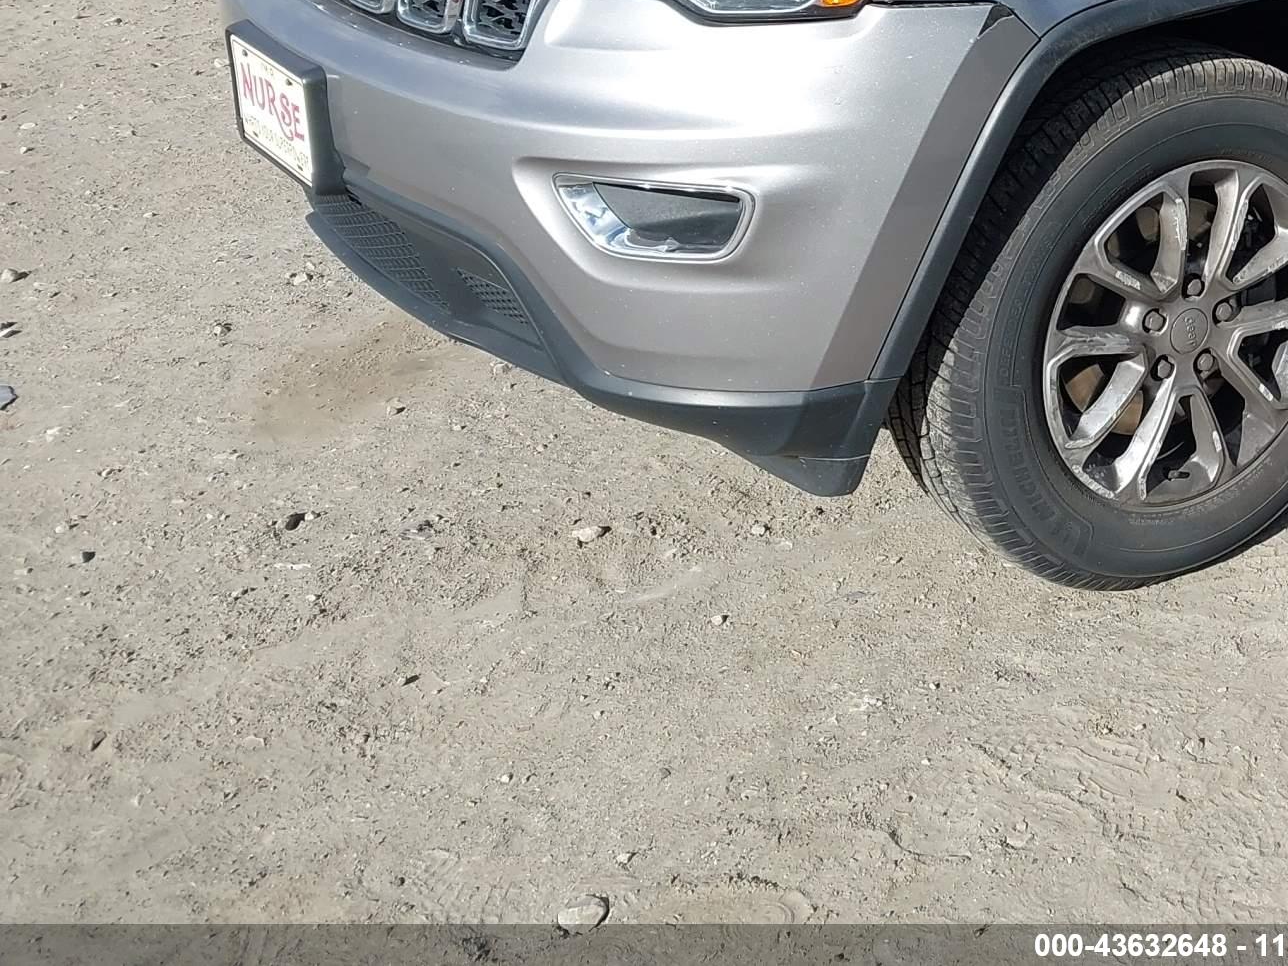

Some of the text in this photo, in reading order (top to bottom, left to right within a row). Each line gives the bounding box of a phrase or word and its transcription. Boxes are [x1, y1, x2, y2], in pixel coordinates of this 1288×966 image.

[240, 62, 305, 142] NURSE
[1184, 316, 1197, 346] Jeep
[999, 404, 1057, 525] MICHELIN
